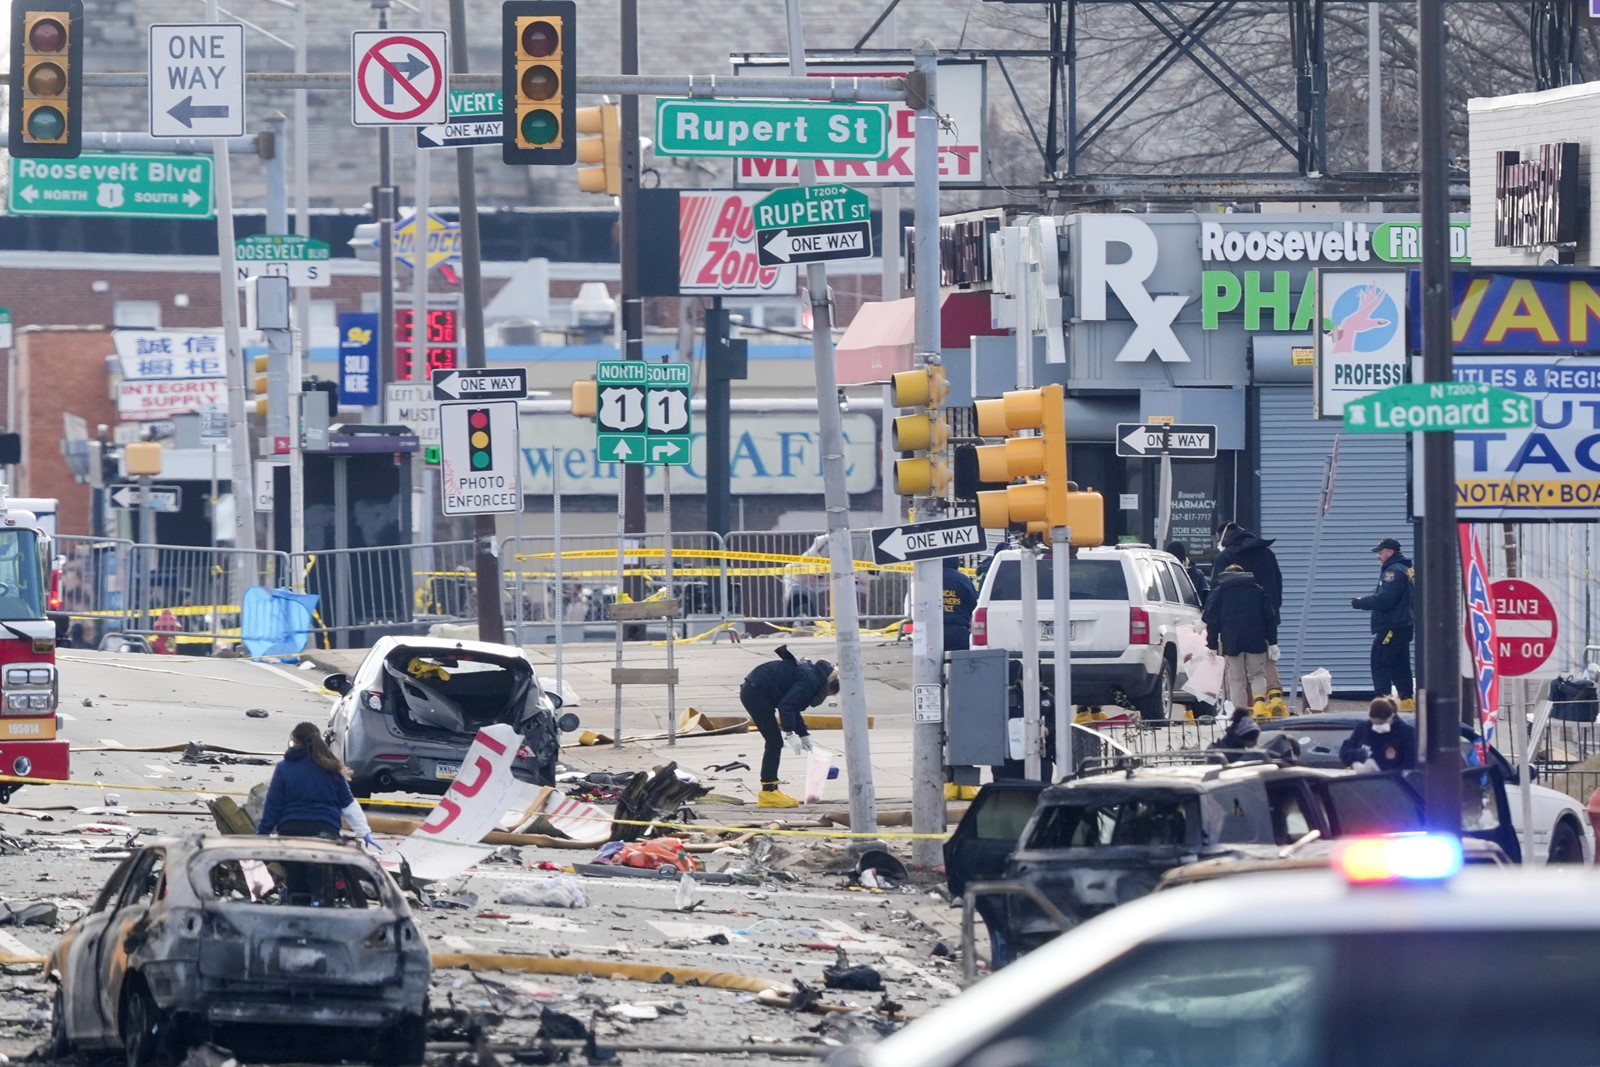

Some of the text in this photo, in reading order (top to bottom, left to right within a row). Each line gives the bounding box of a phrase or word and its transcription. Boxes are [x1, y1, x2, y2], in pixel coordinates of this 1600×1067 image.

[168, 34, 225, 59] ONE
[167, 66, 226, 90] WAY
[445, 123, 501, 138] ONE WAY
[676, 112, 808, 146] Rupert
[827, 114, 868, 144] St
[19, 159, 202, 183] Roosevelt Blvd
[43, 189, 178, 203] NORTH 1 SOUTH
[813, 187, 838, 197] 7200
[760, 199, 865, 227] RUPERT ST
[791, 233, 858, 252] ONE WAY
[1201, 220, 1370, 262] Roosevelt
[236, 244, 329, 259] OOSEVELT BLVD
[238, 266, 248, 280] N
[307, 266, 318, 280] S
[1081, 213, 1191, 362] Rx
[601, 365, 687, 381] NORTH SOUTH
[1524, 369, 1538, 387] &
[344, 374, 369, 392] HERE
[461, 377, 516, 391] ONE WAY
[390, 390, 412, 401] LEFT
[1430, 384, 1476, 399] N 7200
[141, 395, 217, 407] SUPPLY
[400, 408, 436, 422] MUST
[615, 394, 669, 425] 1 1
[1374, 398, 1529, 428] Leonard St
[1147, 434, 1205, 447] ONE WAY
[460, 476, 505, 489] PHOTO
[448, 494, 516, 508] ENFORCED
[1177, 491, 1205, 499] Roosevelt
[1455, 484, 1544, 503] NOTARY
[1170, 500, 1216, 509] HARMACY
[906, 528, 973, 550] ONE WAY
[1493, 599, 1539, 615] ENTE
[1521, 642, 1544, 658] DO
